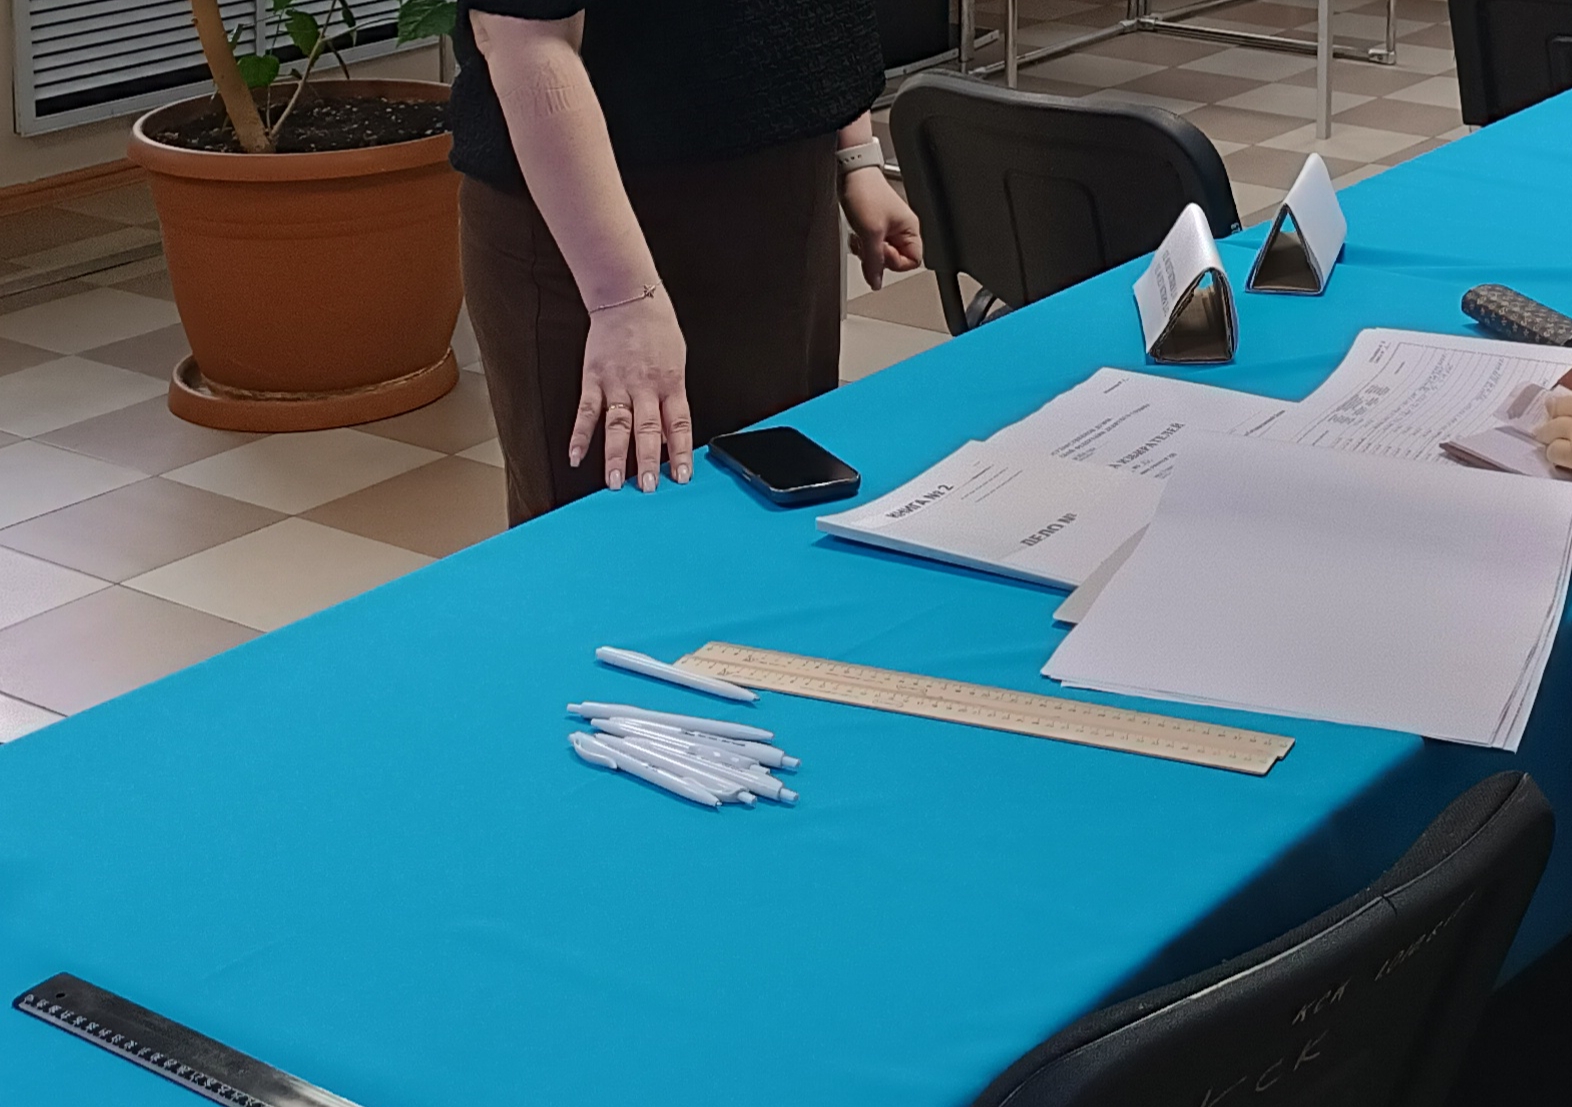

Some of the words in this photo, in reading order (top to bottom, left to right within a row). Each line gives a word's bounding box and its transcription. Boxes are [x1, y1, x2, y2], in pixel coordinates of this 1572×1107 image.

[885, 498, 930, 519] КНИГА
[938, 483, 954, 492] 2
[1020, 521, 1064, 547] ДЕЛО
